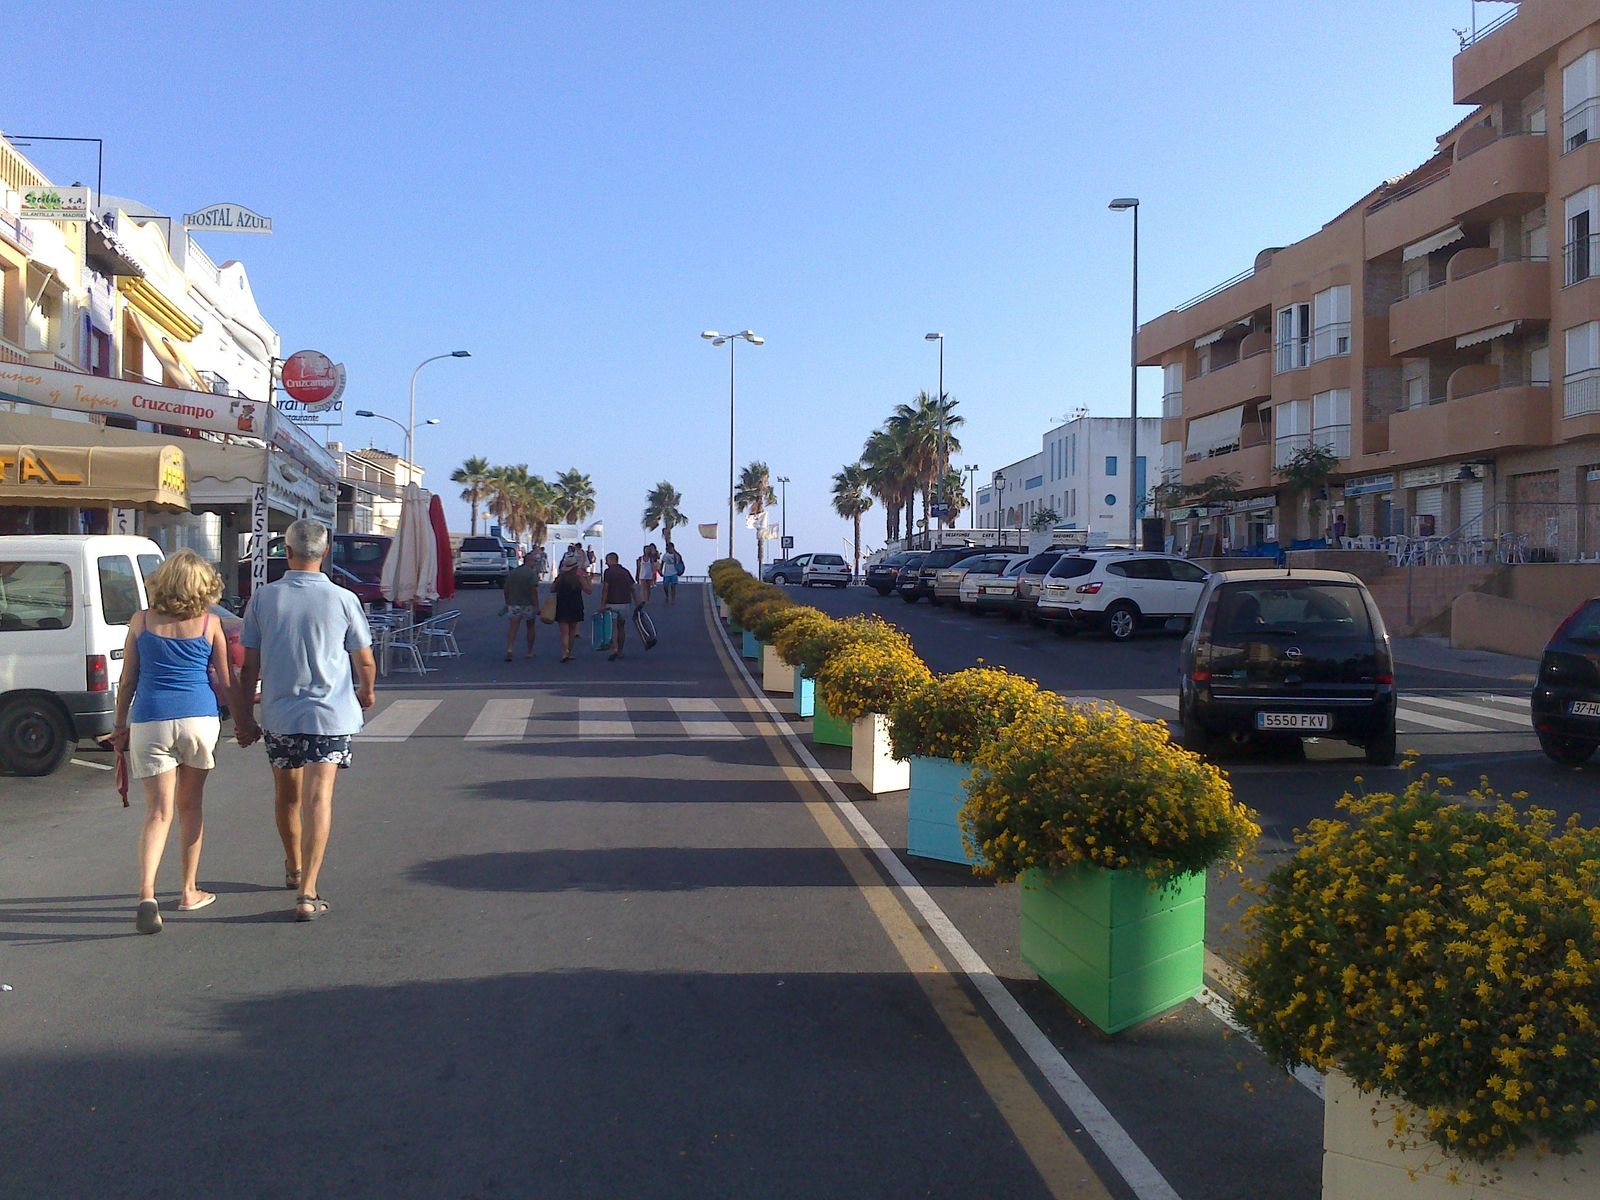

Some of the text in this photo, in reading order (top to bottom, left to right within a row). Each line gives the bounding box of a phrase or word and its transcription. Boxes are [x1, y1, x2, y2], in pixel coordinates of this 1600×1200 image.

[187, 208, 268, 229] HOSTAL AZUL
[286, 378, 336, 389] Cruzcampo
[131, 394, 215, 420] Cruzcampo
[1265, 715, 1325, 727] 5550 FKV
